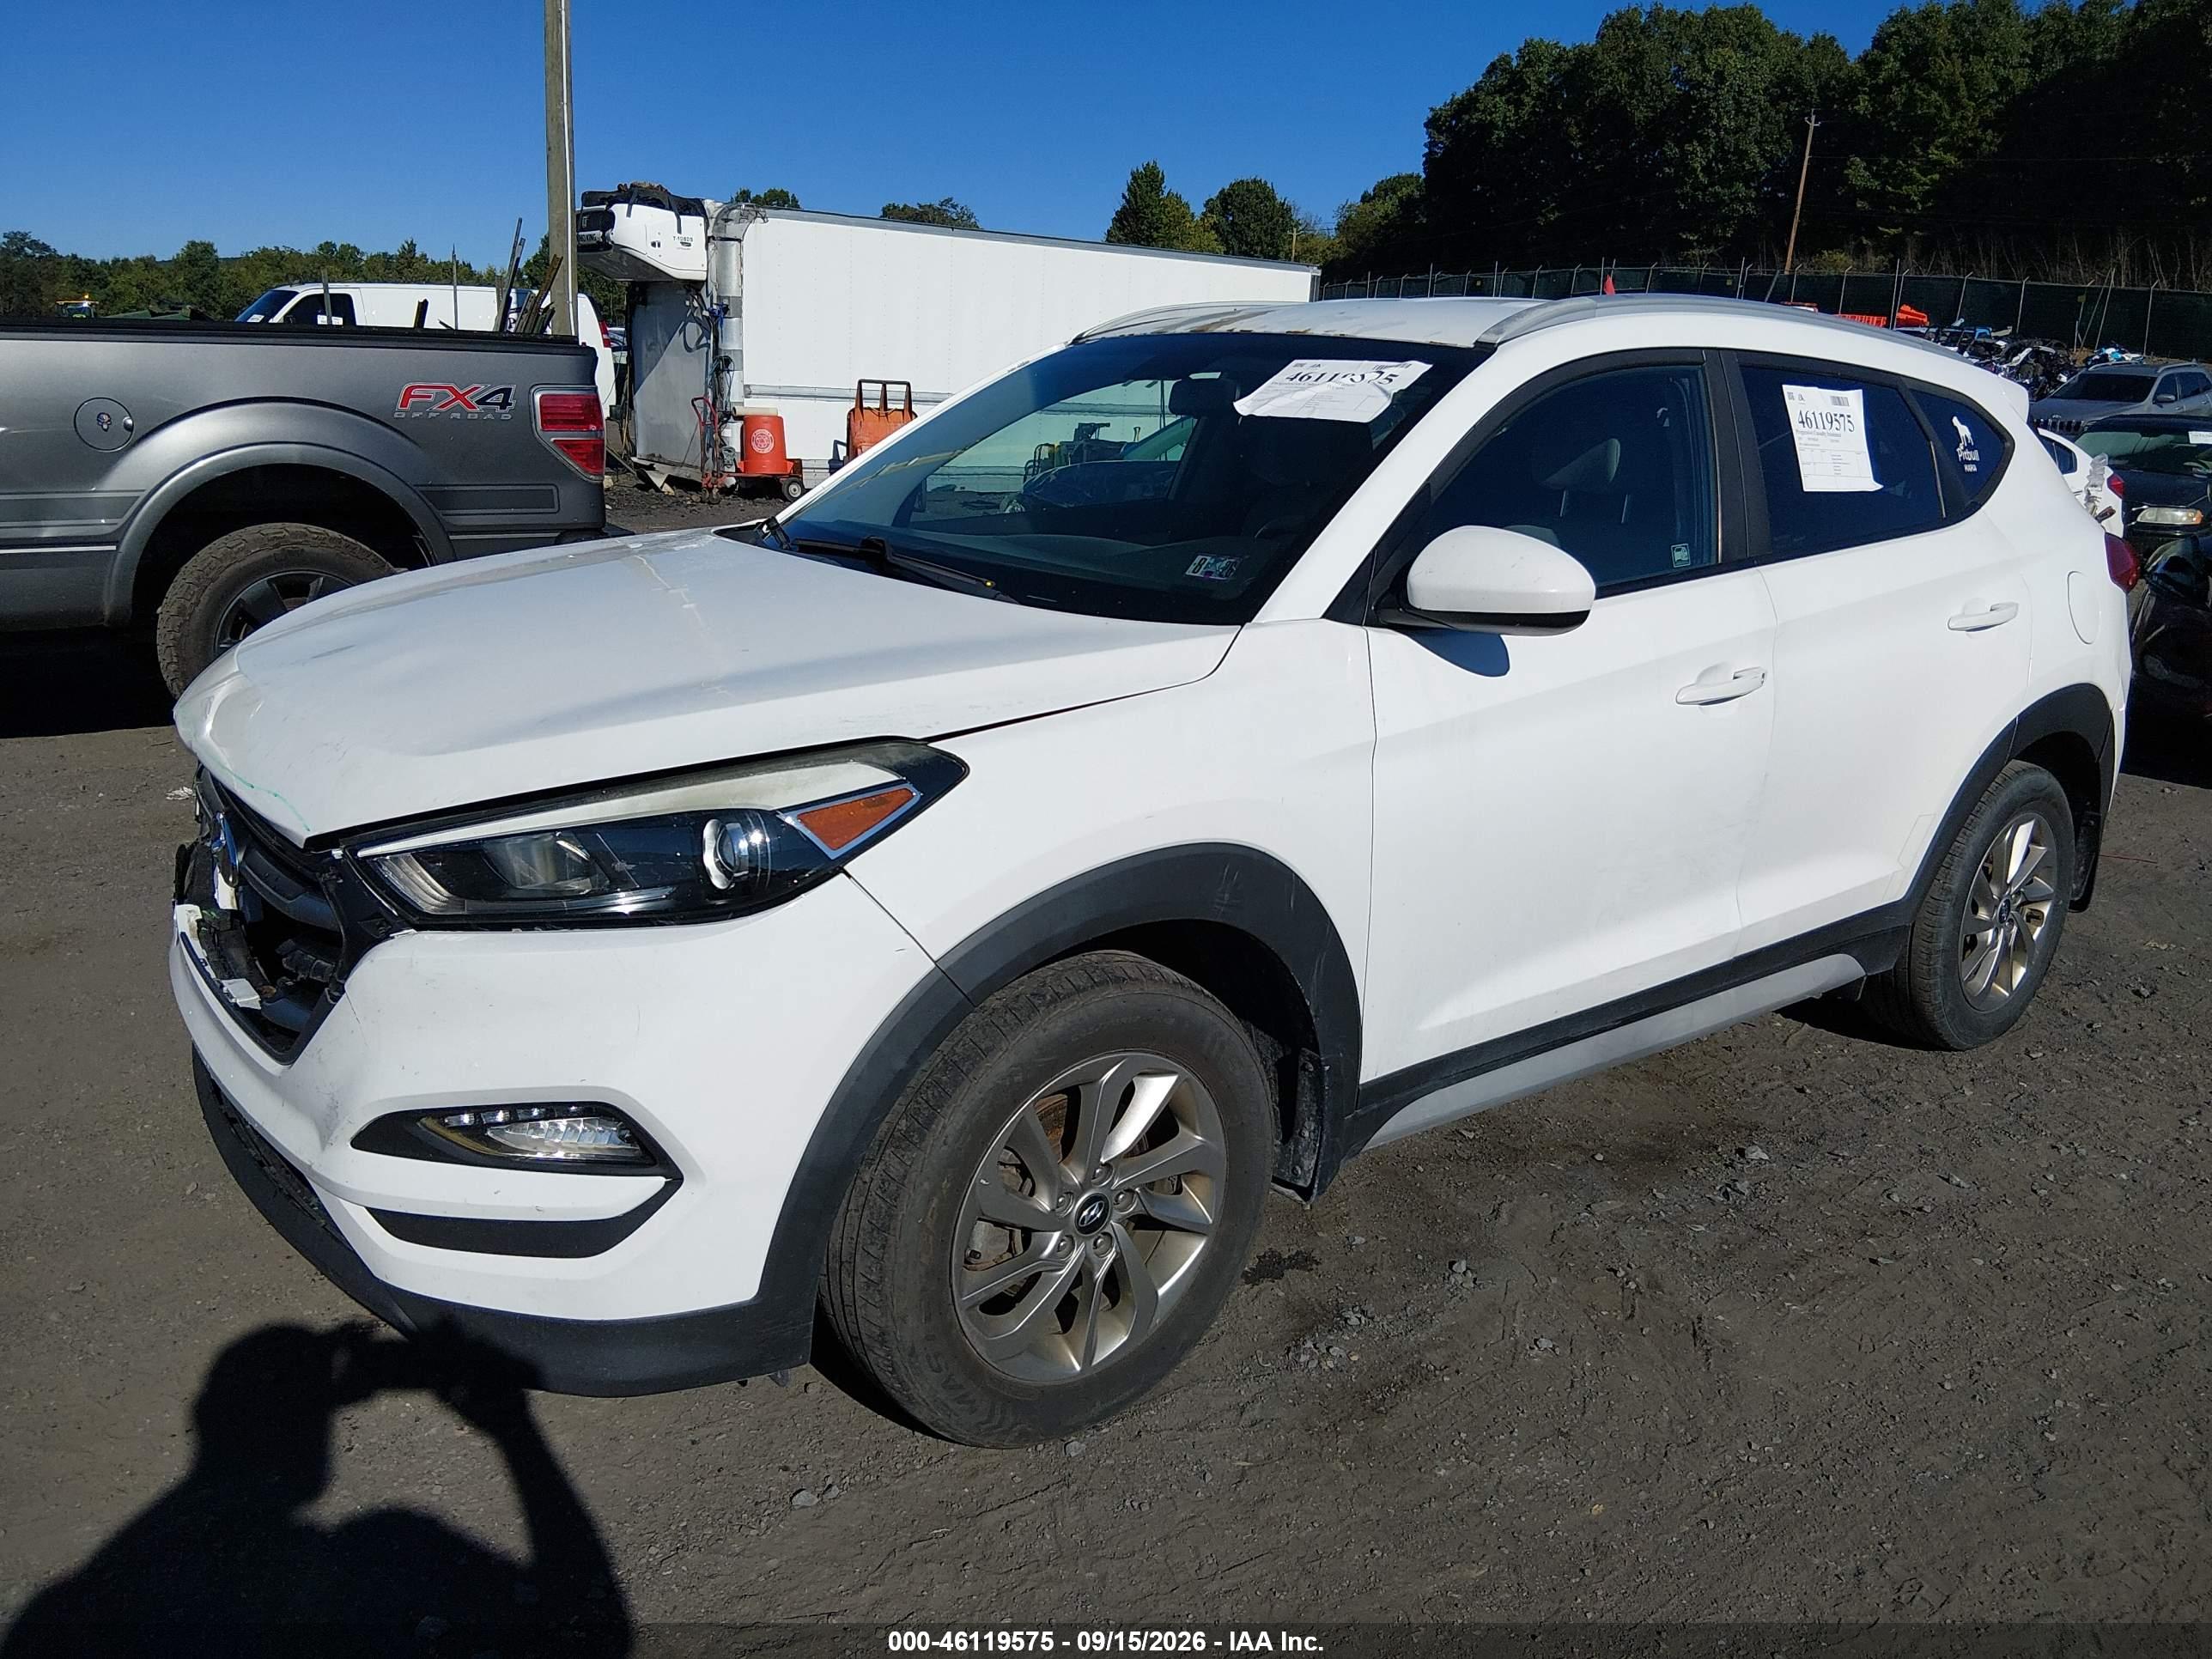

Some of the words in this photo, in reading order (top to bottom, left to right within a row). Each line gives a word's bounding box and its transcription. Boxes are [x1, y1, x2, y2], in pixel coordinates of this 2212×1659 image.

[396, 382, 517, 413] FX4
[393, 411, 441, 420] OFF
[1797, 410, 1855, 433] 46119575
